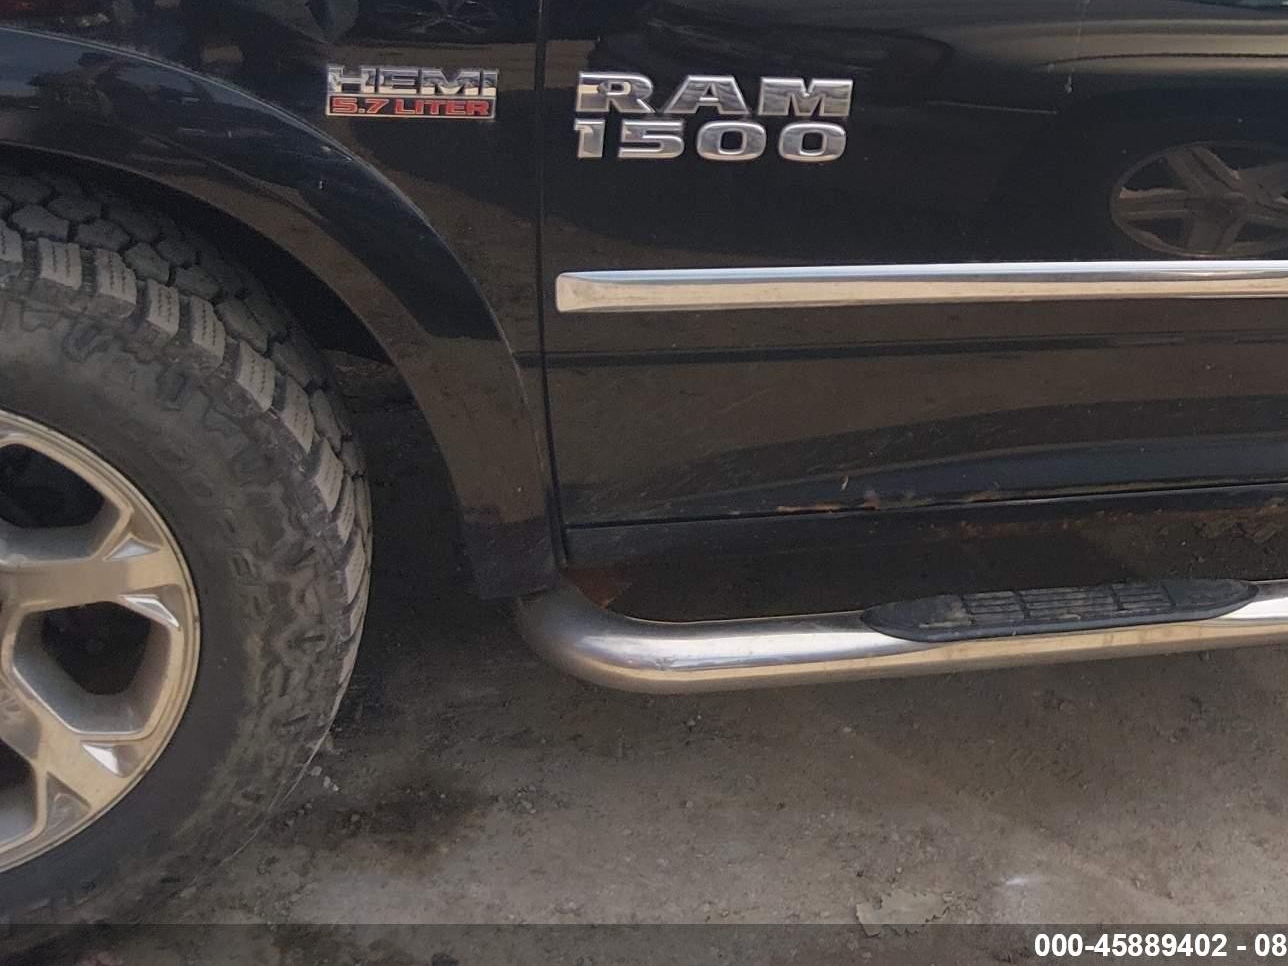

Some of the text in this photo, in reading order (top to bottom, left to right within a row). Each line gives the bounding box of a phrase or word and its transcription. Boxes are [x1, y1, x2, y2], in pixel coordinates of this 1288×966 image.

[327, 65, 498, 95] HEMI
[576, 72, 853, 117] RAM
[331, 97, 490, 116] 5.7 LITER
[574, 118, 847, 161] 1500
